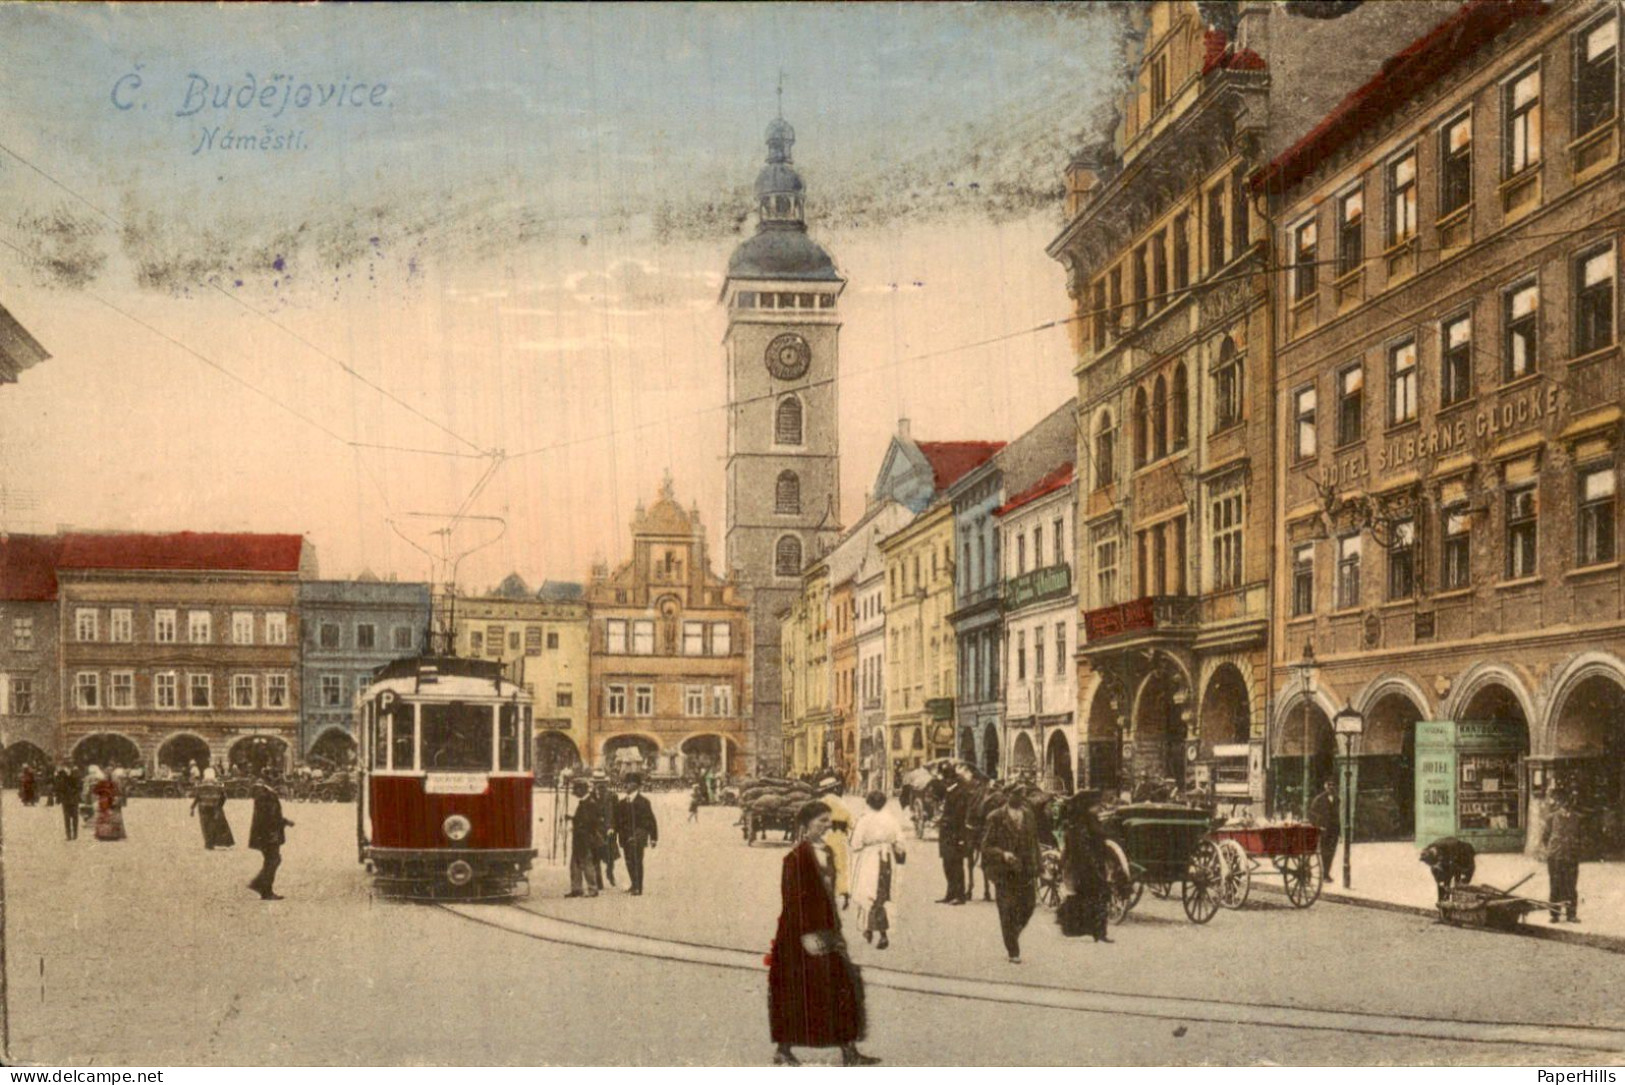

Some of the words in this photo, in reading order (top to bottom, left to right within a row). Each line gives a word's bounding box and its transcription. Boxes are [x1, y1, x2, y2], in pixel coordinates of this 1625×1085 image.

[1321, 455, 1370, 487] HOTEL
[1378, 421, 1466, 470] SILBERNE
[381, 690, 395, 710] P
